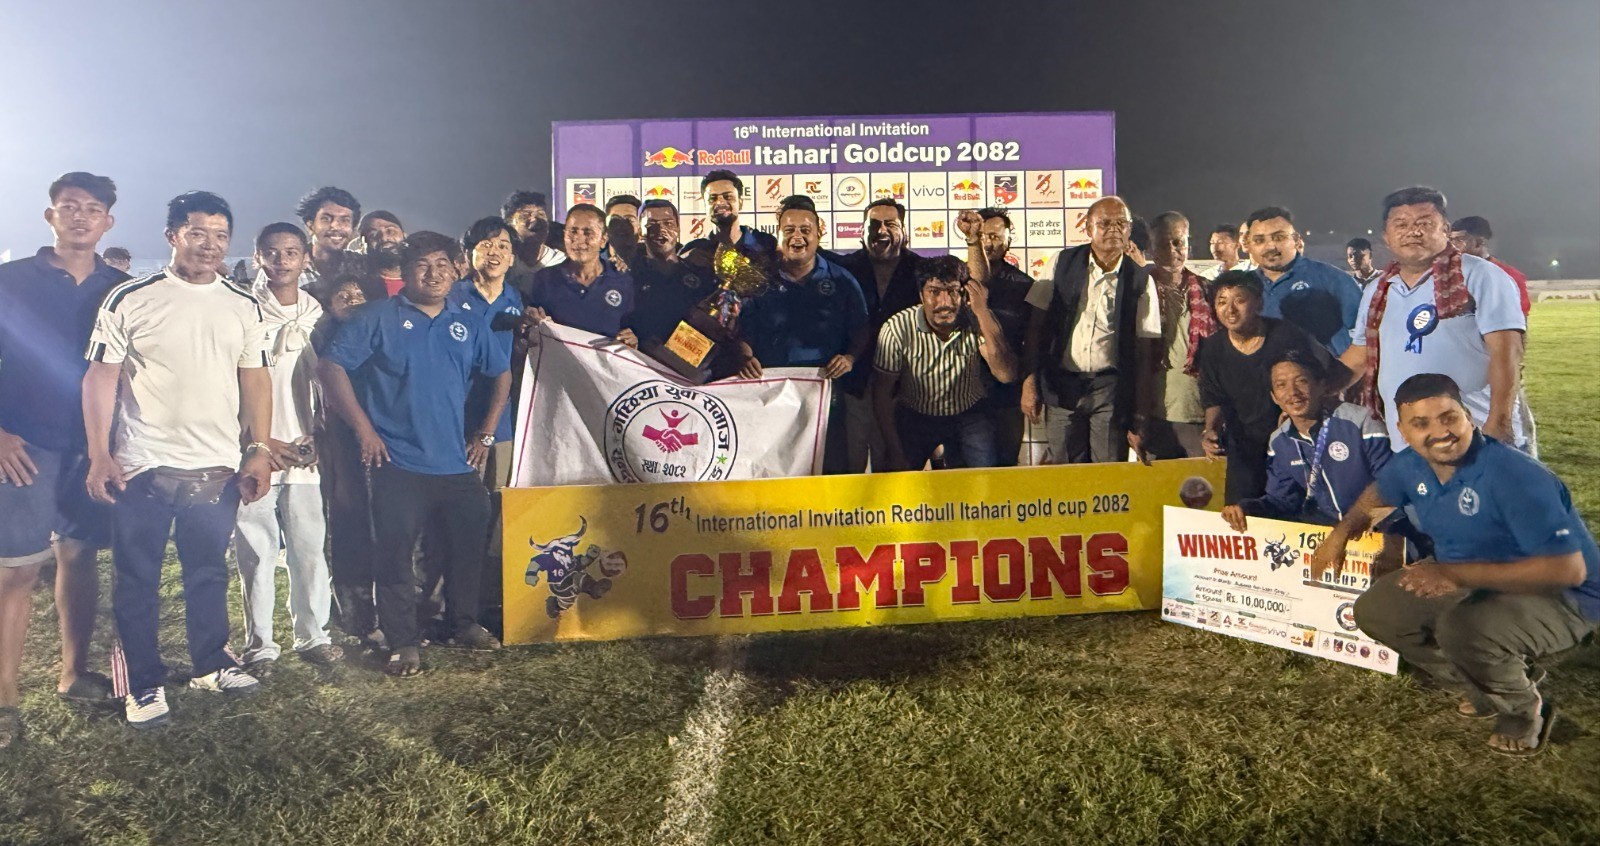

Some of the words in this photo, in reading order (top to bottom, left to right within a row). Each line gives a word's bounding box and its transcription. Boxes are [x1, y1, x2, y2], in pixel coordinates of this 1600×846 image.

[733, 125, 759, 139] 16th
[762, 123, 856, 138] International
[859, 122, 930, 137] Invitation
[755, 143, 838, 165] Itahari
[844, 141, 952, 167] Goldcup
[956, 141, 1020, 161] 2082
[912, 184, 945, 197] vivo
[663, 385, 700, 401] युवा
[702, 395, 730, 452] समाज
[634, 496, 692, 534] 16th
[696, 509, 803, 533] International
[808, 505, 886, 528] Invitation
[892, 502, 955, 523] Redbull
[960, 499, 1011, 520] Itahari
[1017, 498, 1052, 522] gold
[1057, 498, 1087, 518] cup
[1092, 493, 1130, 513] 2082
[1177, 533, 1259, 561] WINNER
[552, 568, 565, 577] 16
[670, 531, 1131, 620] CHAMPIONS
[1267, 628, 1287, 639] vivo
